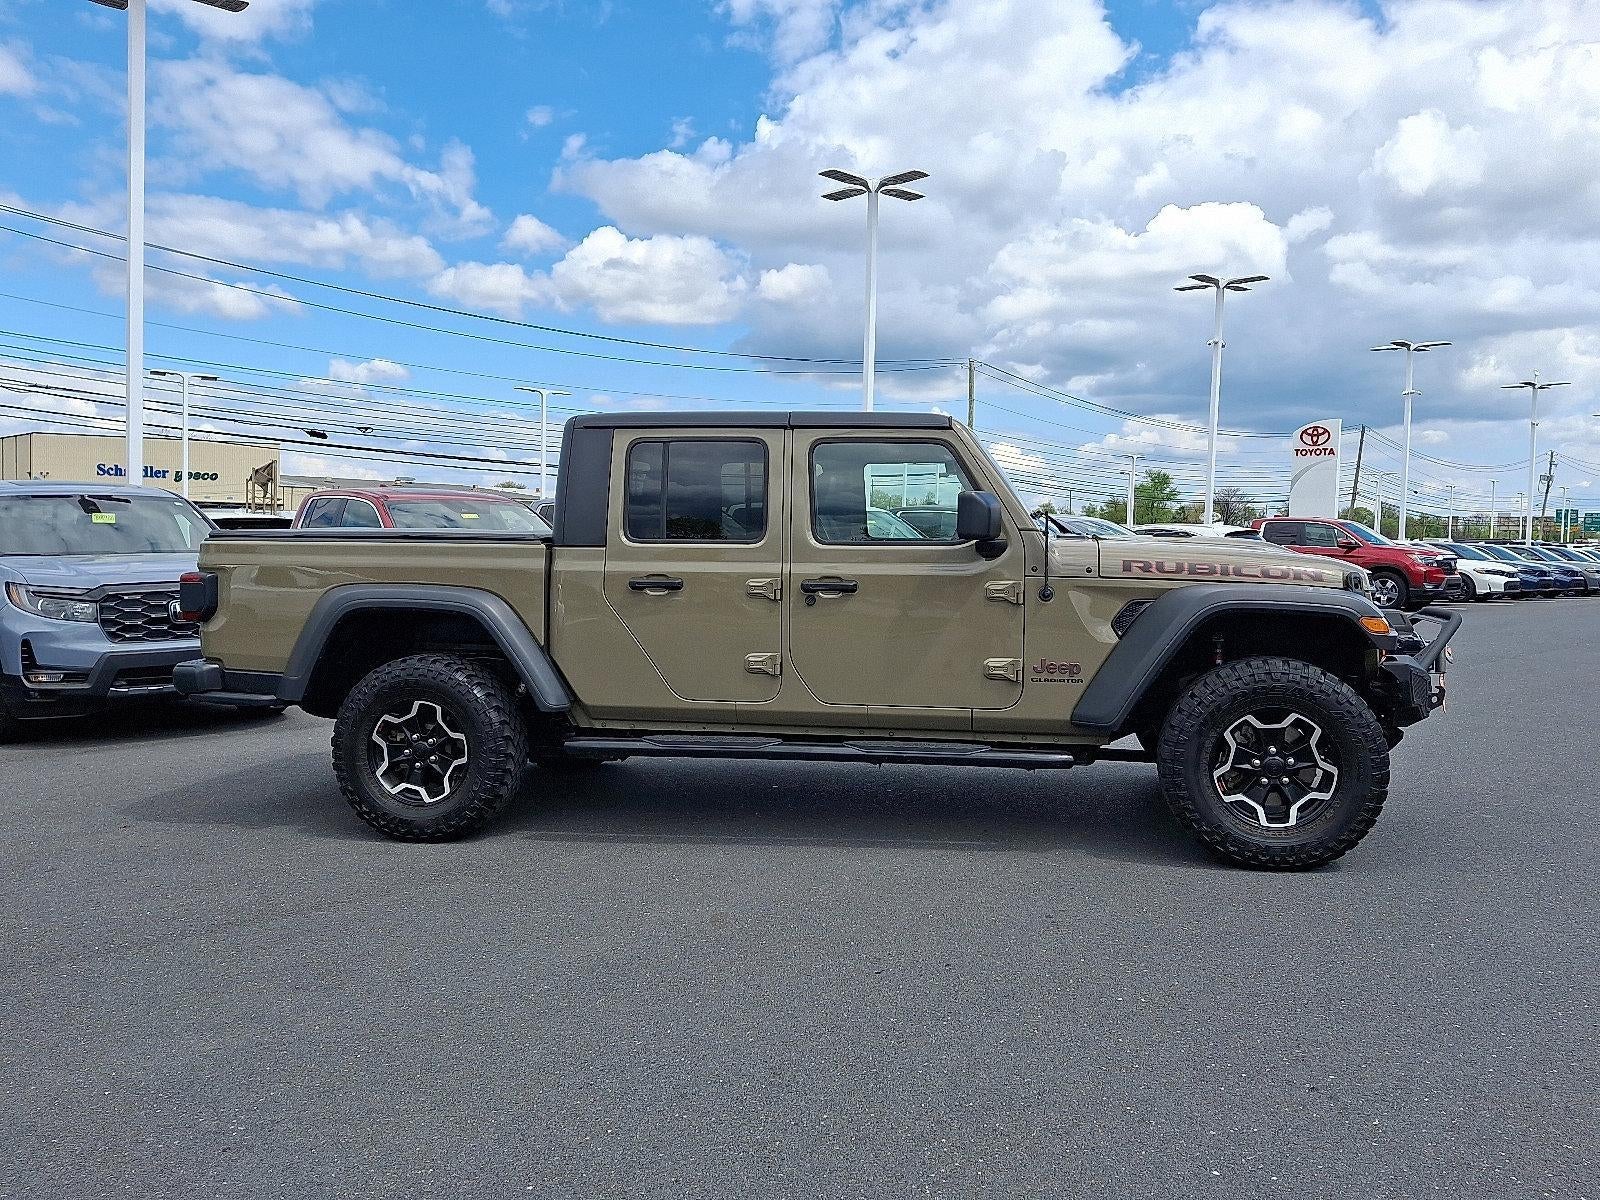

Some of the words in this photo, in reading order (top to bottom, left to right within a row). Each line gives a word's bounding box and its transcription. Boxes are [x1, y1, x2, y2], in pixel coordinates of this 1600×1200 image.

[1294, 447, 1336, 457] TOYOTA
[96, 463, 170, 479] Schdler
[1121, 559, 1326, 582] RUBICON
[1032, 657, 1082, 677] Jeep
